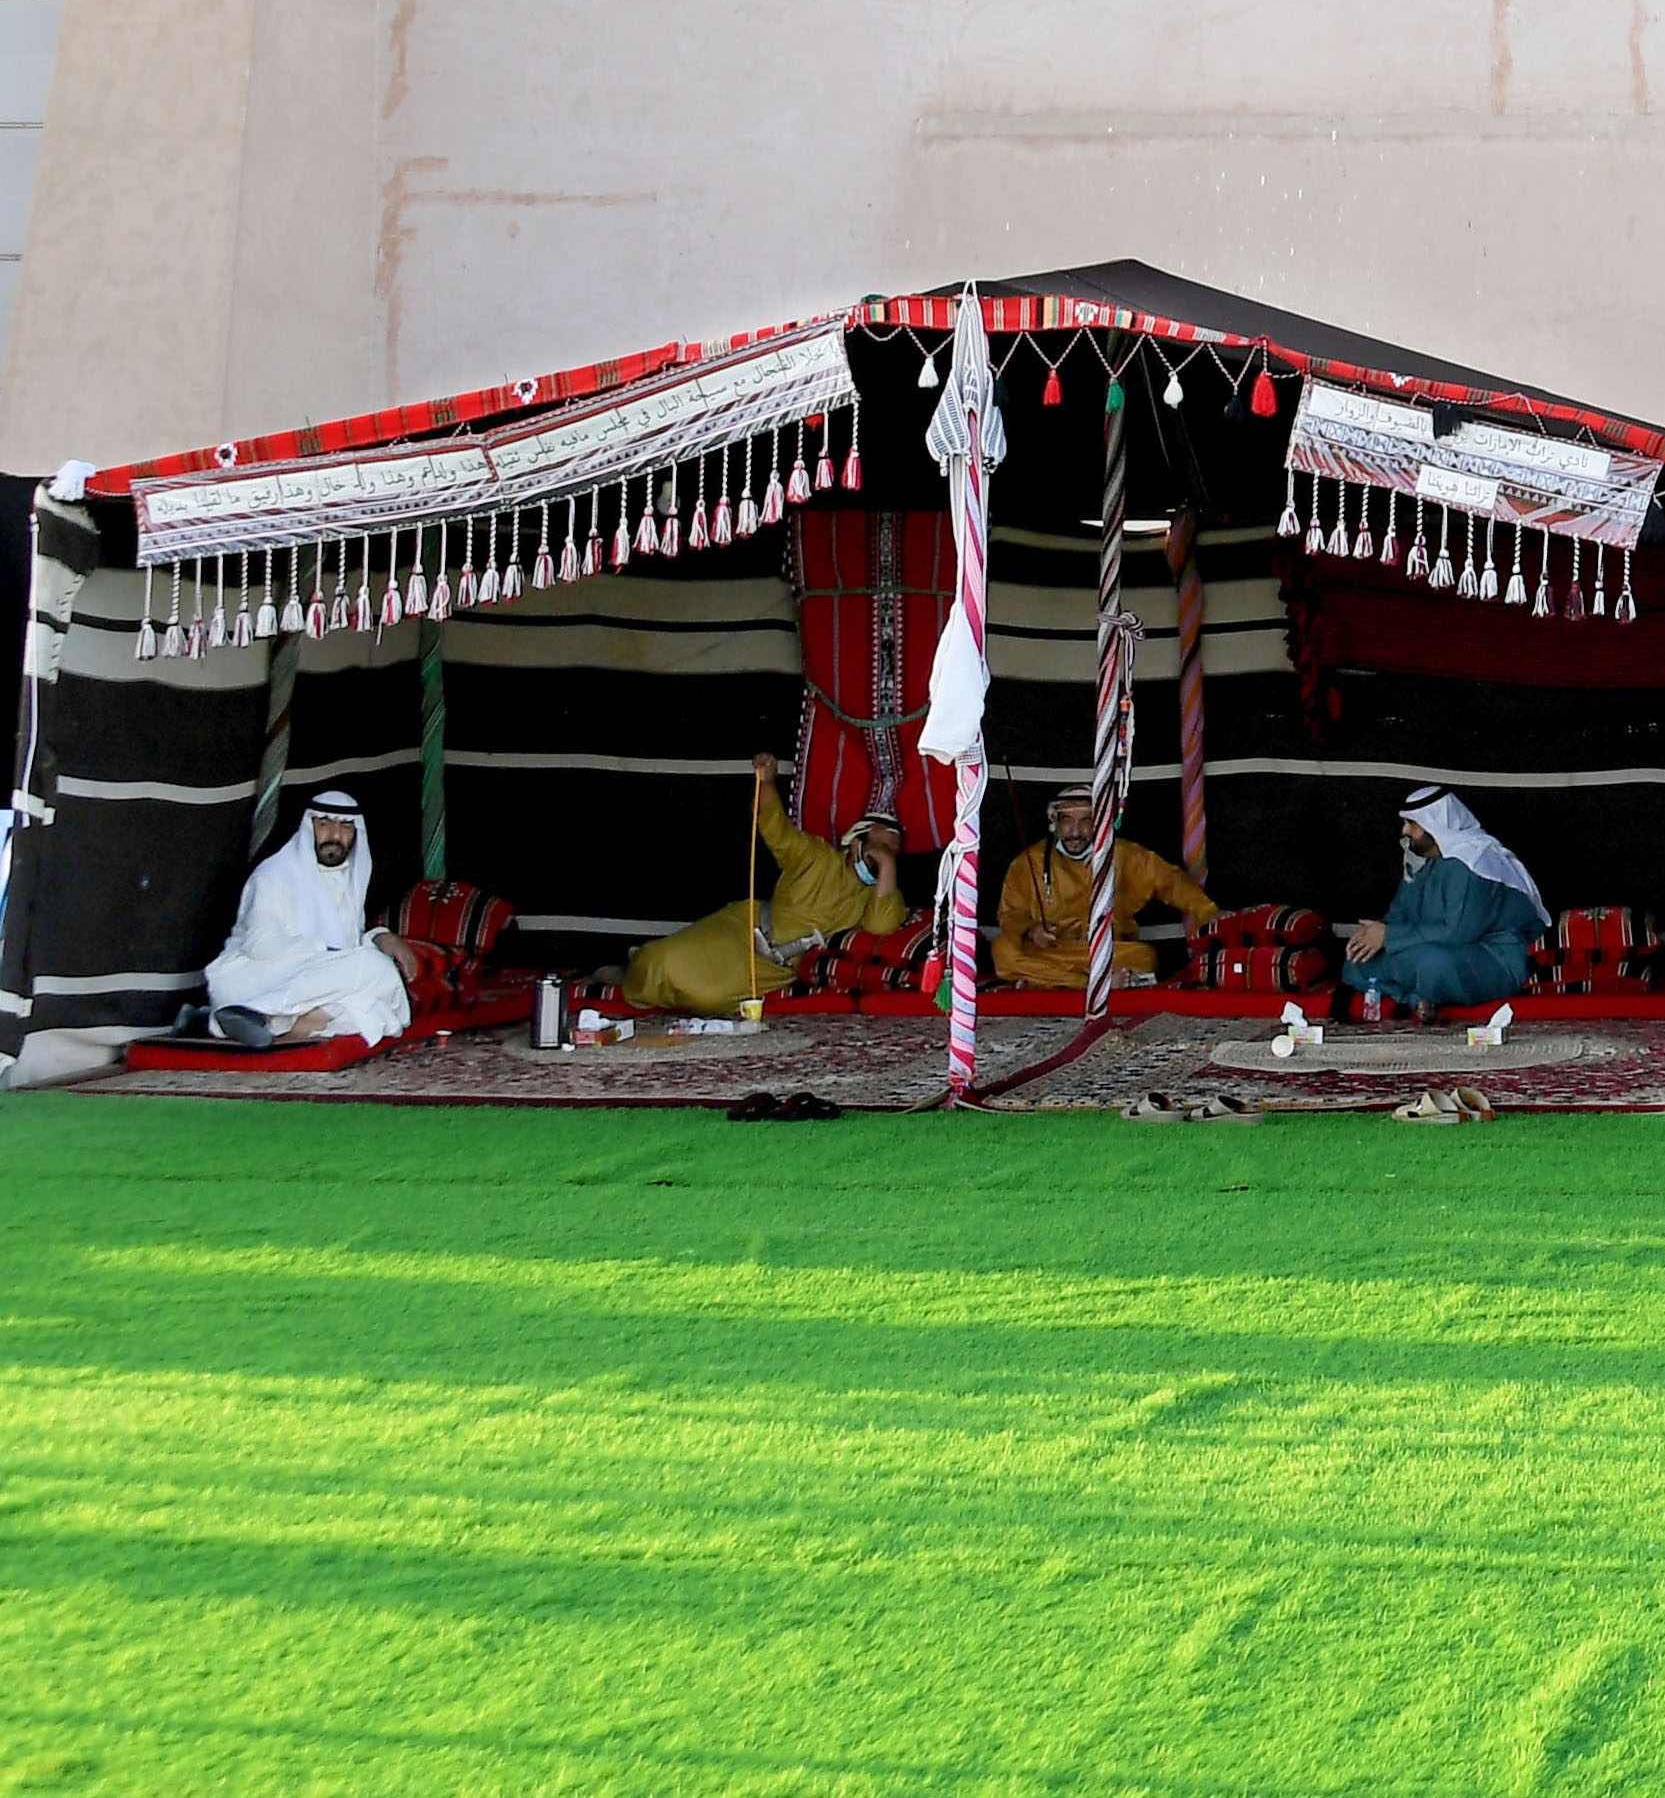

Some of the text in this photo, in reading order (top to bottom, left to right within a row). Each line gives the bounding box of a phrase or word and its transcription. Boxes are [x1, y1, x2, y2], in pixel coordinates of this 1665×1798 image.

[637, 407, 651, 429] في
[1334, 400, 1375, 423] والزوار
[1377, 413, 1428, 435] بالضيوف
